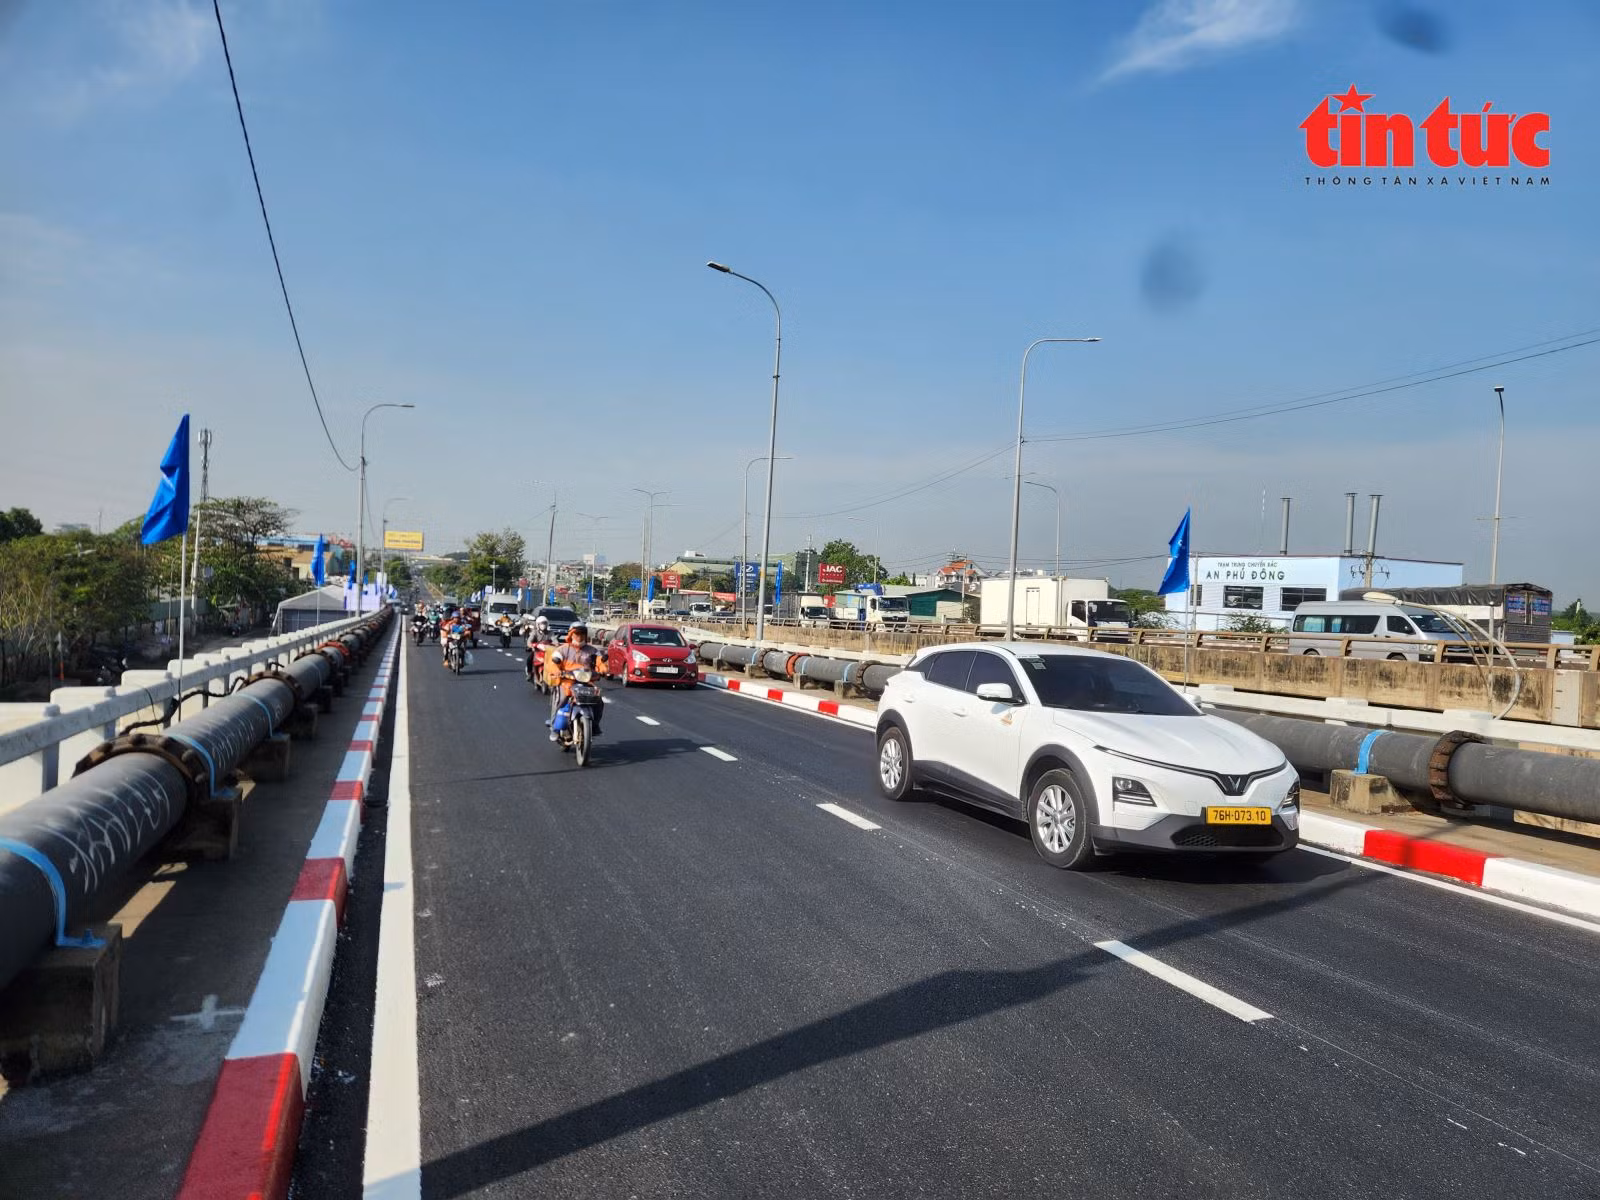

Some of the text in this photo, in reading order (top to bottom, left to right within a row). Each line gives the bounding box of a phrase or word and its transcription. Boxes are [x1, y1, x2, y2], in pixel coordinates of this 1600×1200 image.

[1206, 567, 1285, 581] AN PHÚ ĐÔNG
[1212, 809, 1267, 821] 76H-073.10
